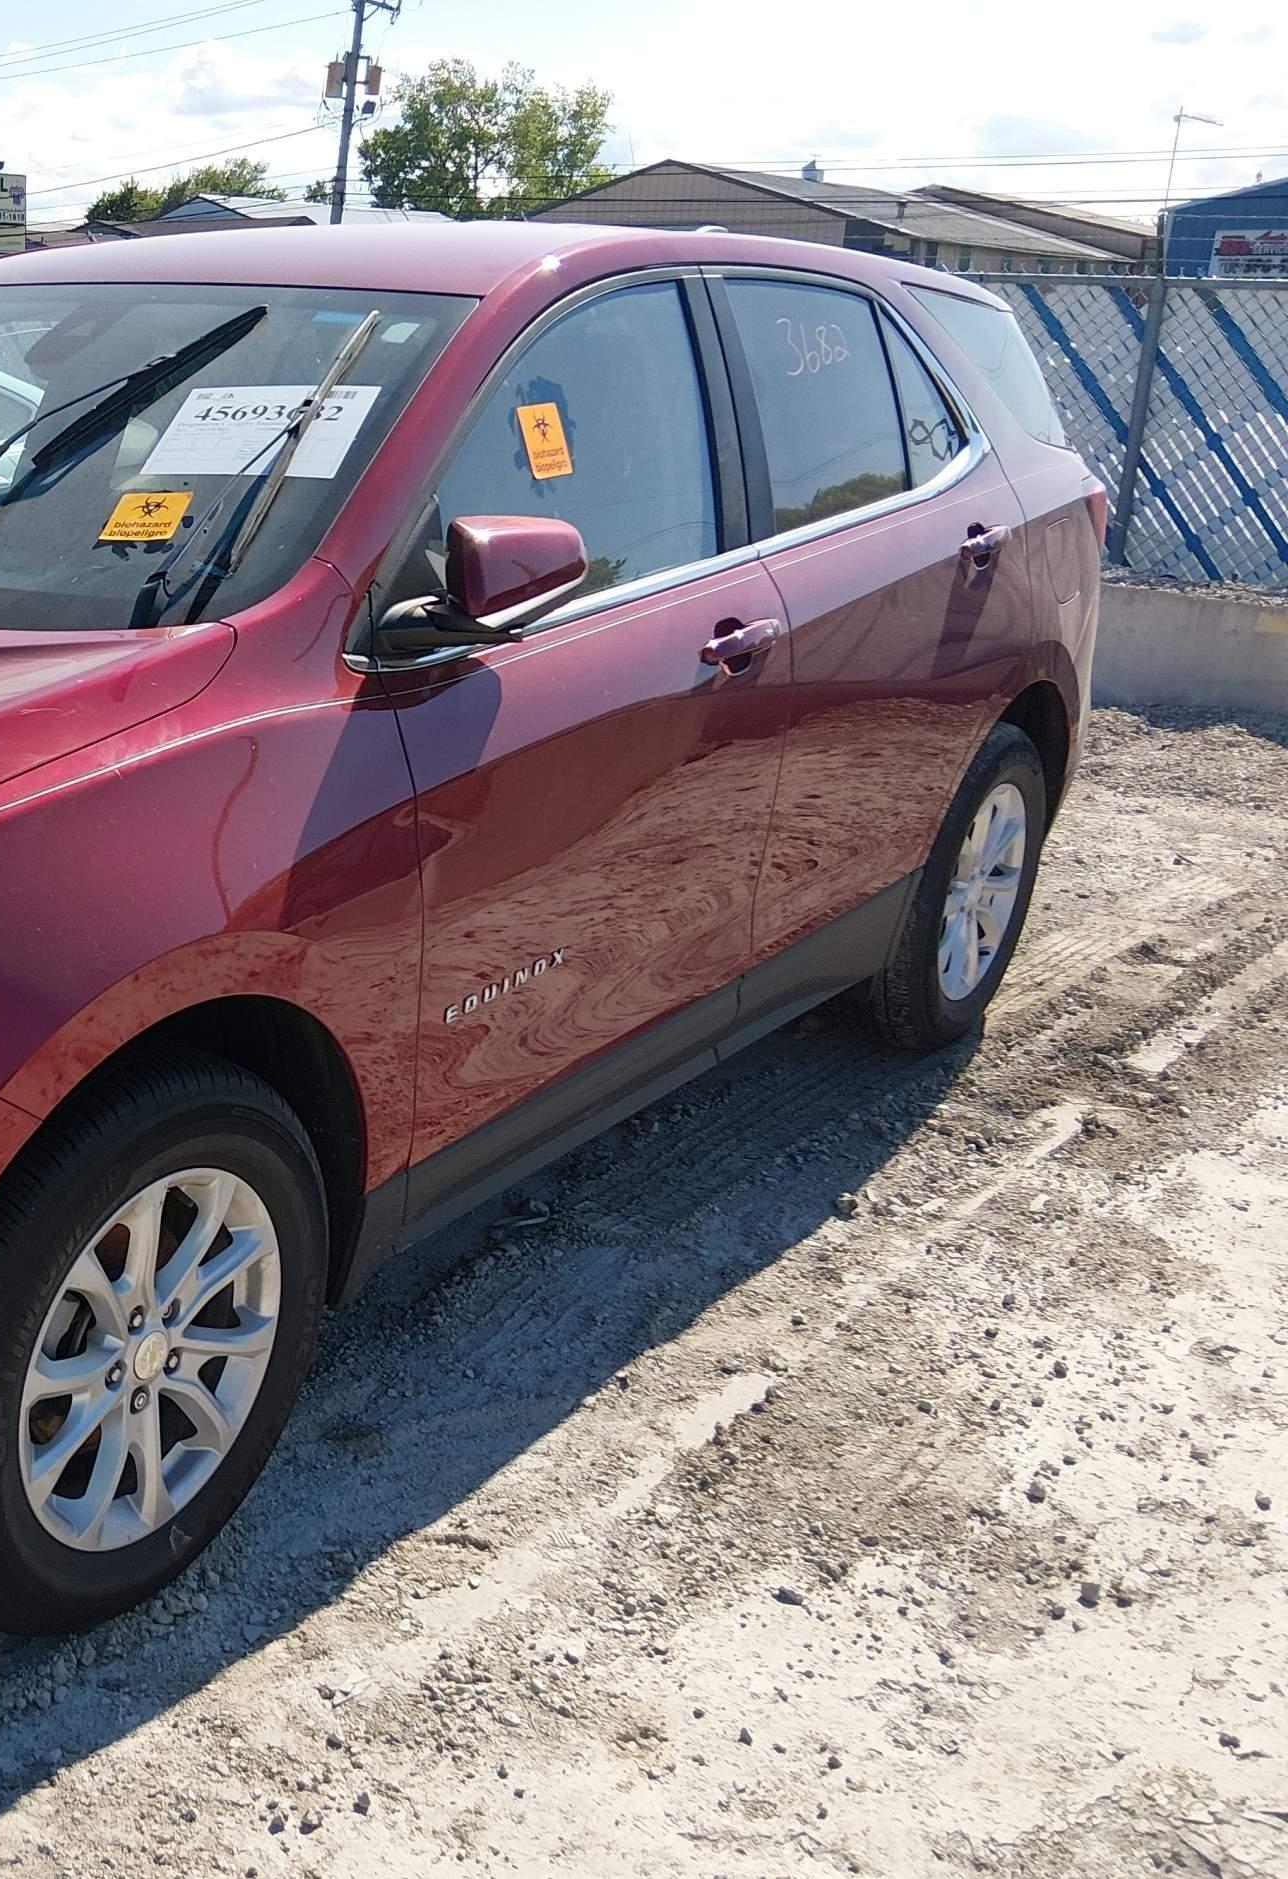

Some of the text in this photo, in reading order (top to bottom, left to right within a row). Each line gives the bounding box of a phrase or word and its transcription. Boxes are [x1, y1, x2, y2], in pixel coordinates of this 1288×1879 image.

[776, 317, 851, 376] 3682
[108, 529, 169, 538] biopeligro
[444, 948, 566, 1024] EQUINOX
